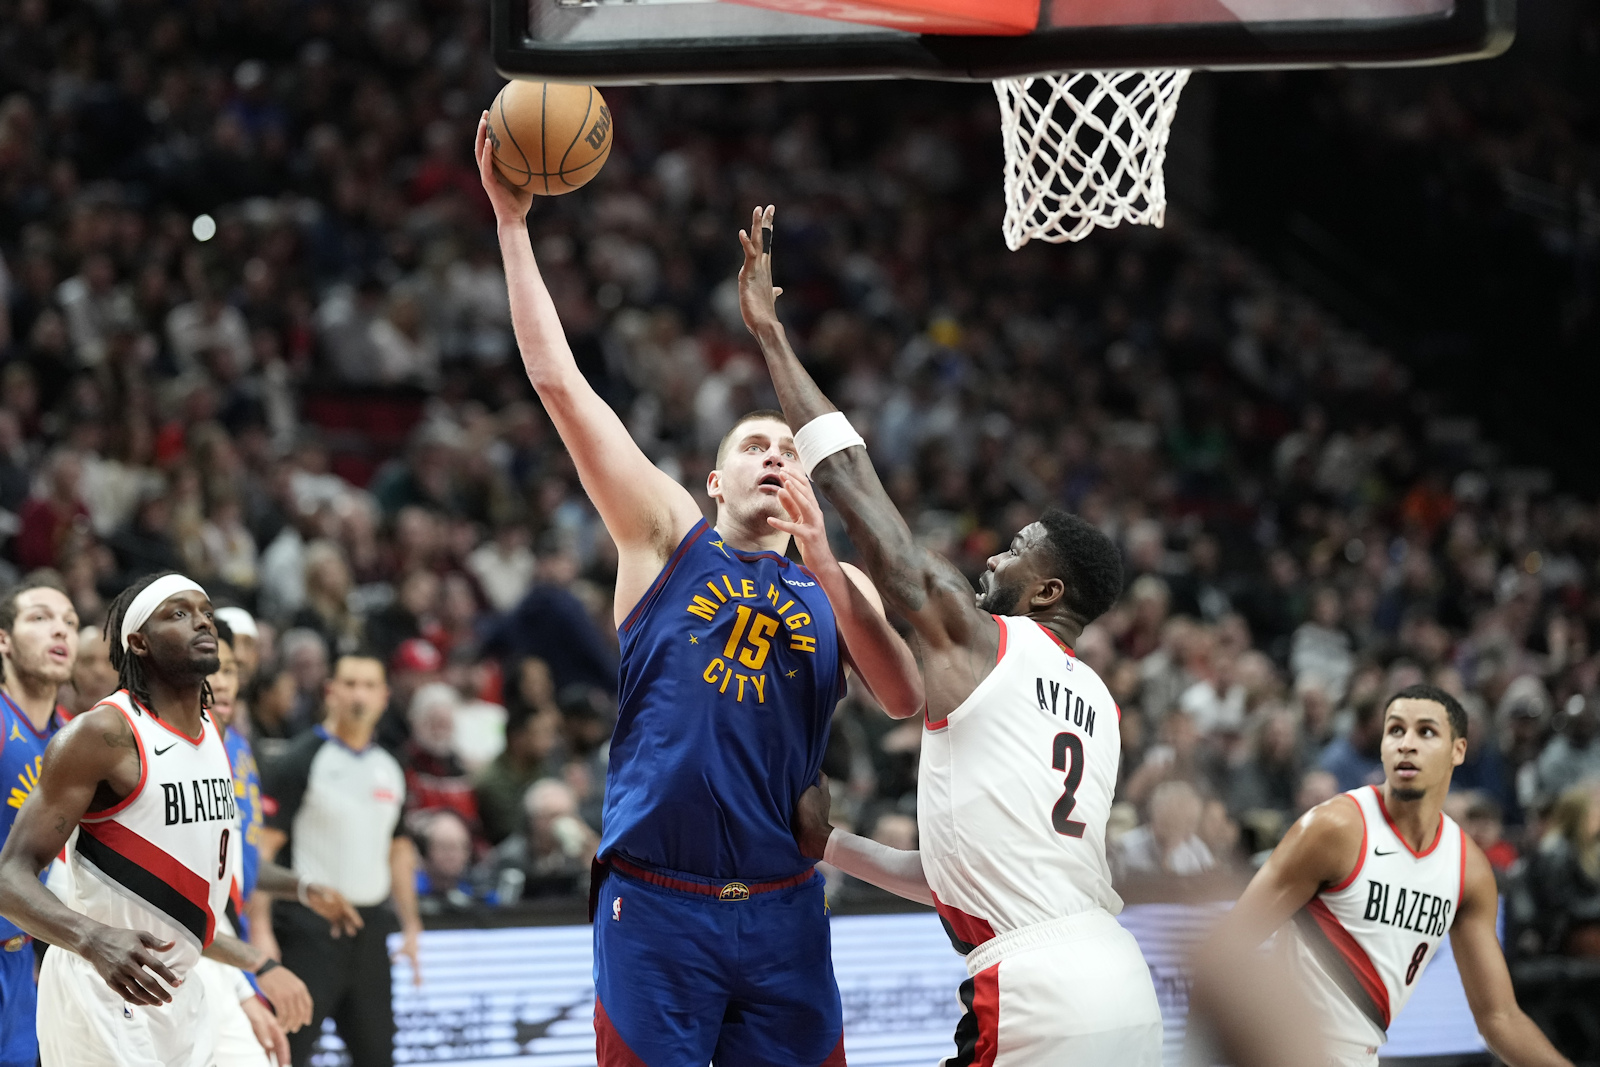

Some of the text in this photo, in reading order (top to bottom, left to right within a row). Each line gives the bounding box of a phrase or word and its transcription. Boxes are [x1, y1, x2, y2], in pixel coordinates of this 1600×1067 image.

[686, 574, 816, 653] MILE HIGH
[722, 604, 780, 671] 15
[702, 657, 766, 704] CITY
[1036, 677, 1096, 738] AYTON
[159, 778, 235, 826] BLAZERS
[1051, 731, 1087, 839] 2
[218, 828, 230, 881] 9
[1363, 879, 1452, 938] BLAZERS
[1405, 942, 1429, 986] 8
